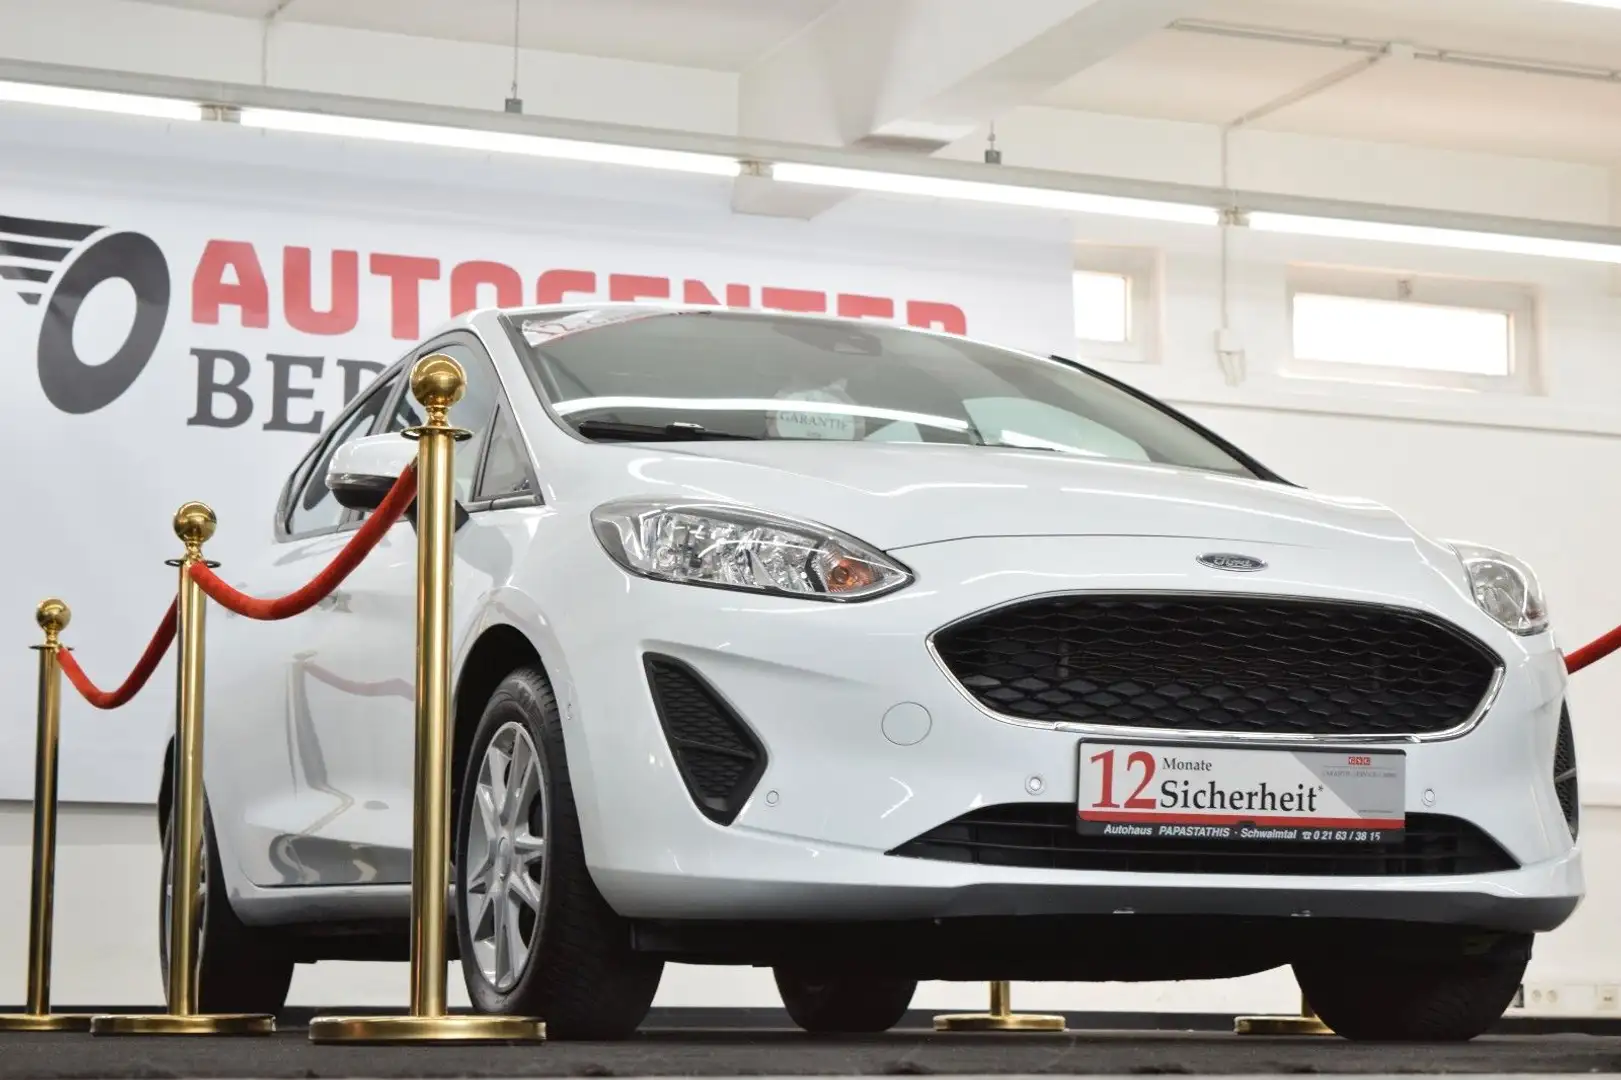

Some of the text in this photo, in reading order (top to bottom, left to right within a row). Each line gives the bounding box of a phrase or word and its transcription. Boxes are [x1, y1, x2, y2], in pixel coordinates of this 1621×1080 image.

[1162, 757, 1213, 772] Monate
[1091, 749, 1156, 809] 12
[1104, 823, 1153, 836] Autohaus
[1158, 825, 1230, 838] PAPASTATHIS
[1240, 828, 1297, 840] Schwalmtal
[1313, 831, 1320, 840] 0
[1321, 831, 1333, 840] 21
[1335, 831, 1347, 841] 63
[1355, 832, 1367, 841] 38
